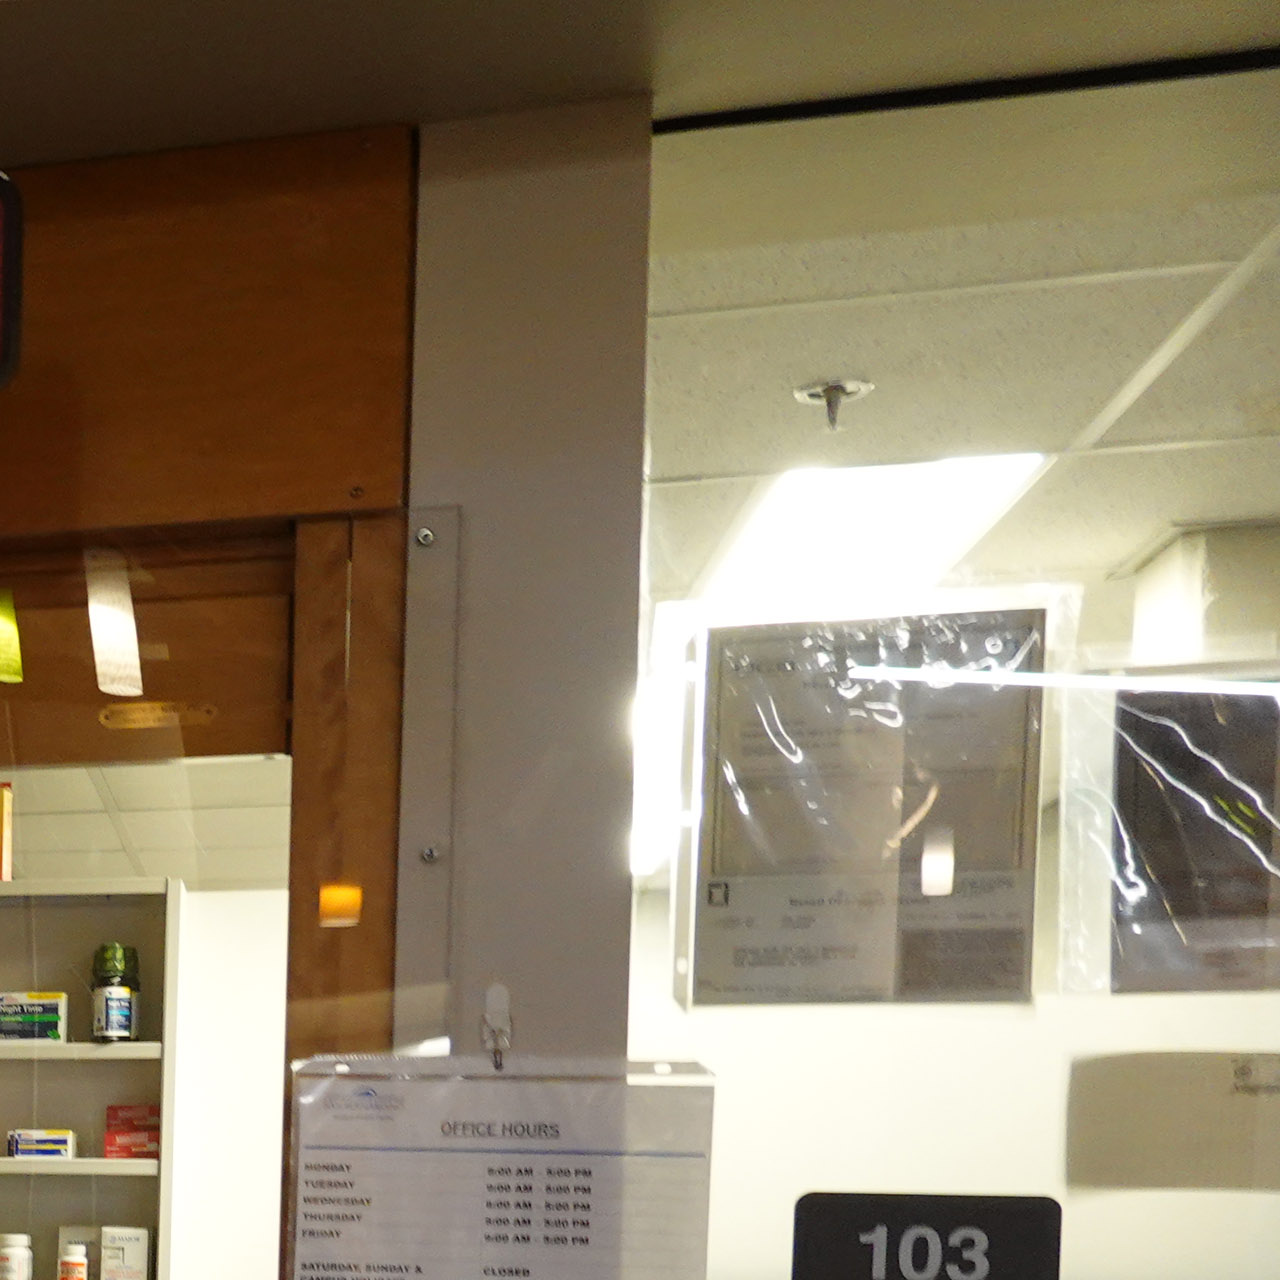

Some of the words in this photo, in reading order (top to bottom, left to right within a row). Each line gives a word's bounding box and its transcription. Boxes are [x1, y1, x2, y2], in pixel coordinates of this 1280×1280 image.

[0, 1004, 23, 1015] Night
[24, 1004, 44, 1013] Time
[440, 1121, 495, 1138] OFFICE
[501, 1122, 560, 1140] HOURS
[304, 1163, 352, 1173] MONDAY
[515, 1167, 533, 1176] AM
[574, 1168, 592, 1177] PM
[303, 1180, 355, 1189] TUESDAY
[514, 1184, 533, 1194] AM
[574, 1185, 592, 1195] PM
[302, 1196, 372, 1206] WEDNESDAY
[514, 1201, 532, 1210] AM
[573, 1202, 591, 1212] PM
[303, 1213, 363, 1223] THURSDAY
[513, 1217, 531, 1227] AM
[572, 1219, 590, 1228] PM
[301, 1229, 343, 1239] FRIDAY
[512, 1234, 531, 1243] AM
[571, 1236, 589, 1245] PM
[300, 1262, 361, 1274] SATURDAY,
[365, 1264, 410, 1274] SUNDAY
[414, 1265, 423, 1275] &
[483, 1267, 530, 1278] CLOSED
